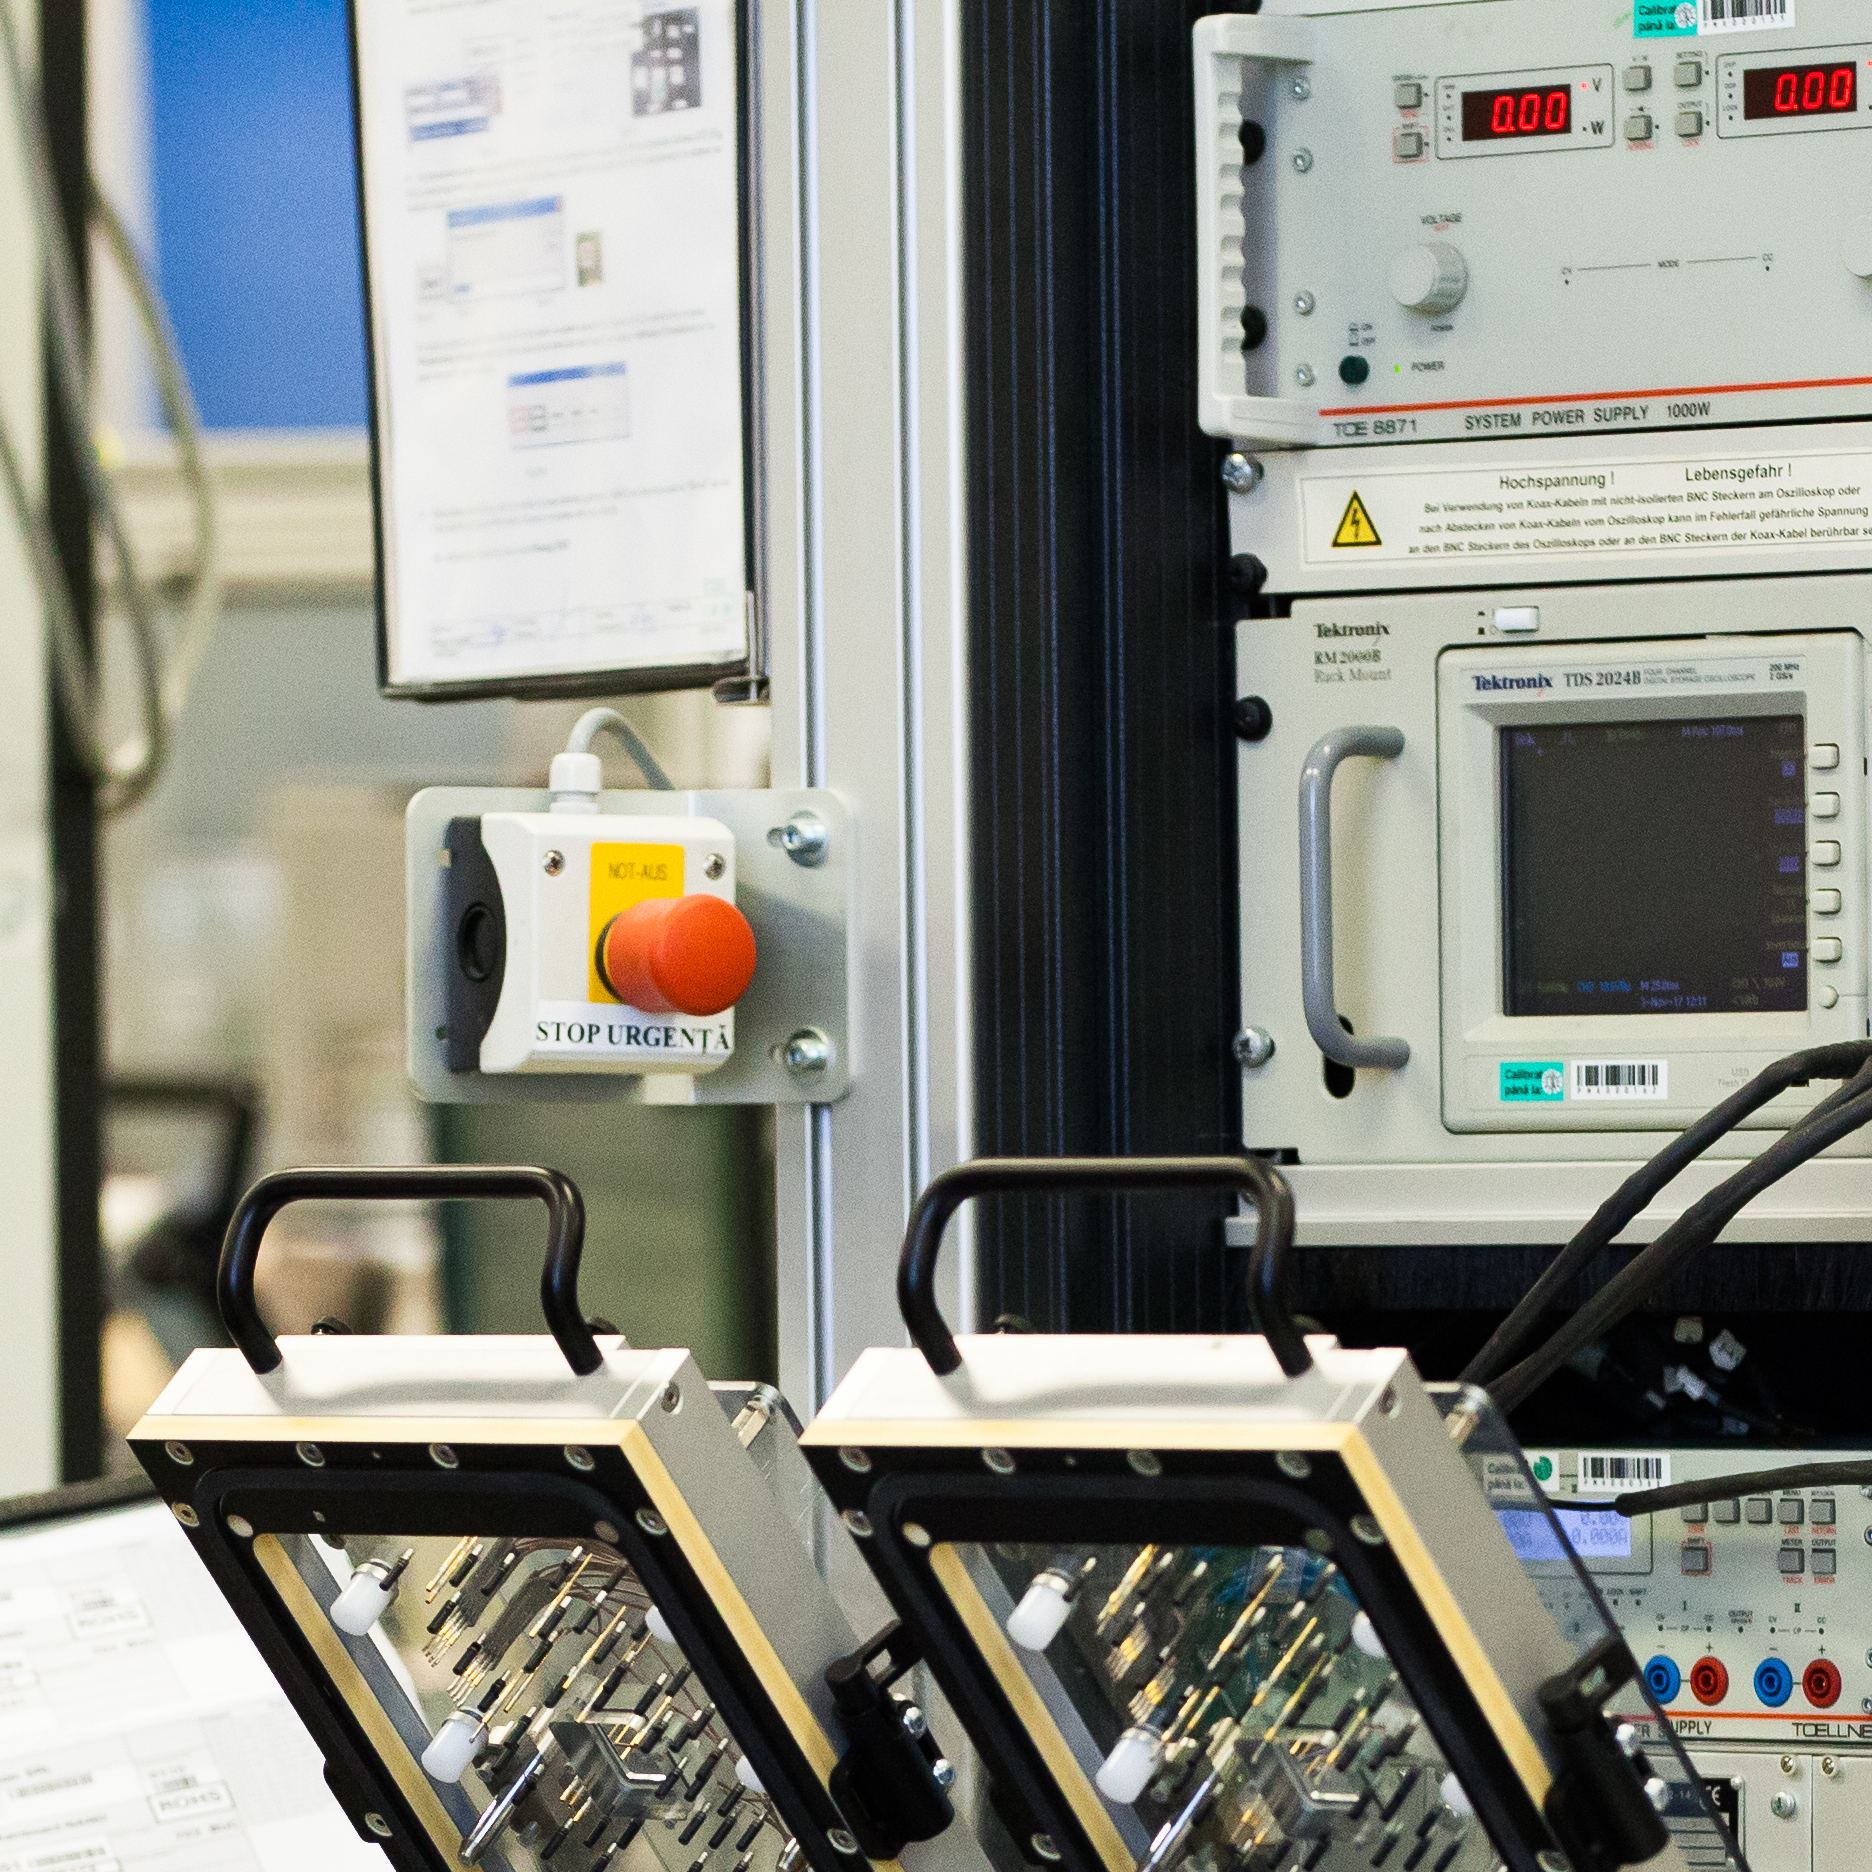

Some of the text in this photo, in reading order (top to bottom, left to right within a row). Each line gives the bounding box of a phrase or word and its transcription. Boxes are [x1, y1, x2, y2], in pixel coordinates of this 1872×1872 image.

[1592, 78, 1602, 92] V
[1775, 69, 1852, 111] 0.00
[1491, 92, 1567, 132] 0.00
[1591, 120, 1605, 135] W
[1465, 402, 1711, 430] SYSTEM POWER SUPPLY 1000W
[1373, 419, 1417, 434] 8871
[1499, 473, 1606, 490] Hochspannung
[1685, 463, 1784, 483] Lebensgefahr
[1687, 486, 1861, 502] BNC Steckern am Oszilloskop oder
[1668, 512, 1693, 524] kann
[1710, 509, 1756, 521] Fehlerfall
[1759, 507, 1815, 522] gefährliche
[1817, 506, 1869, 518] Spannung
[1599, 536, 1620, 546] oder
[1660, 533, 1682, 544] BNC
[1684, 531, 1728, 542] Steckern
[1731, 531, 1748, 541] der
[1750, 527, 1807, 540] Koax-Kabel
[1811, 525, 1859, 538] berührbar
[1314, 621, 1390, 638] Tektronix
[1472, 671, 1641, 690] Tektronix TDS 2024B
[536, 1021, 601, 1045] STOP
